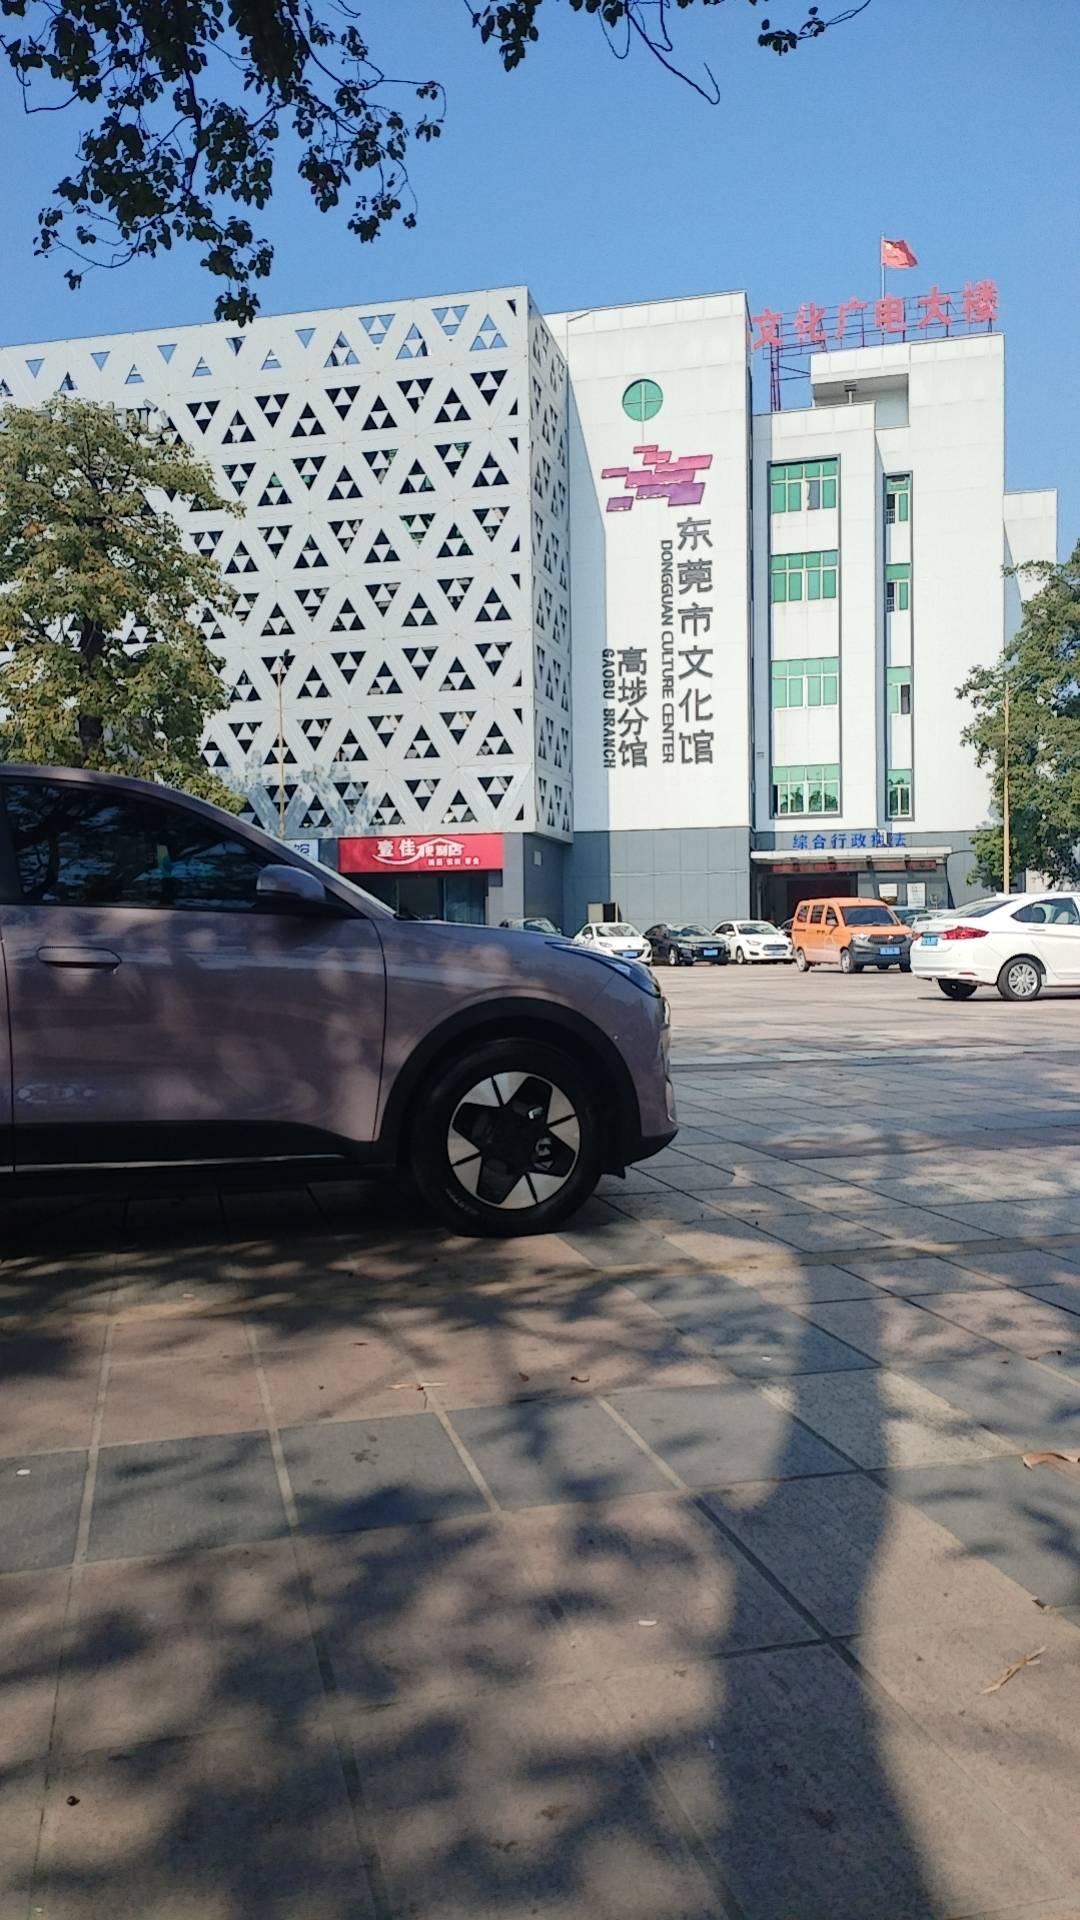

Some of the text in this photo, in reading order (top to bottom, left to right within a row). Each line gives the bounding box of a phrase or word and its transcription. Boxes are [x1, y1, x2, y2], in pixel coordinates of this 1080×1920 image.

[752, 278, 1000, 349] 文化广电大楼
[602, 648, 617, 769] GAOBU BRANCH
[660, 539, 675, 764] DONGGUAN CULTURE CENTER
[677, 516, 714, 765] 东莞市文化馆
